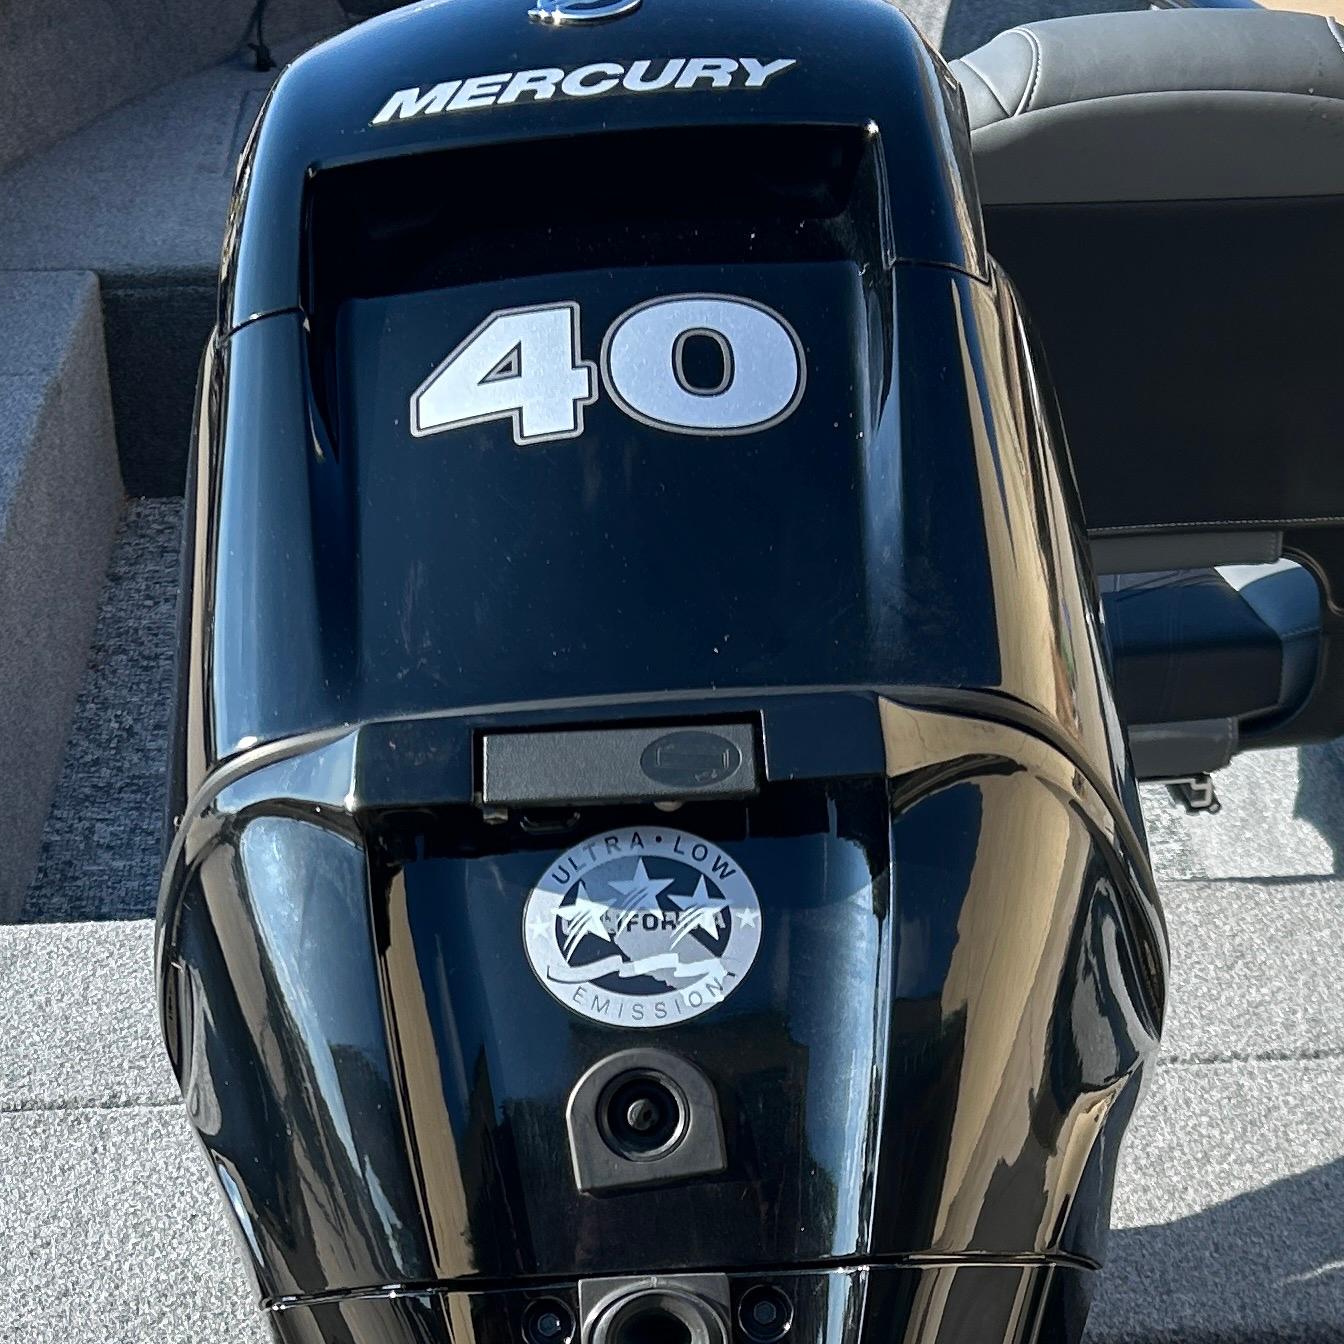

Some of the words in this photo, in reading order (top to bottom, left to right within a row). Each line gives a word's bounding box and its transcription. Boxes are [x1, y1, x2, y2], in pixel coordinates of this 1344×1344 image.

[370, 57, 797, 125] MERCURY
[410, 293, 807, 446] 40
[551, 831, 645, 885] ULTRA
[673, 835, 737, 881] LOW
